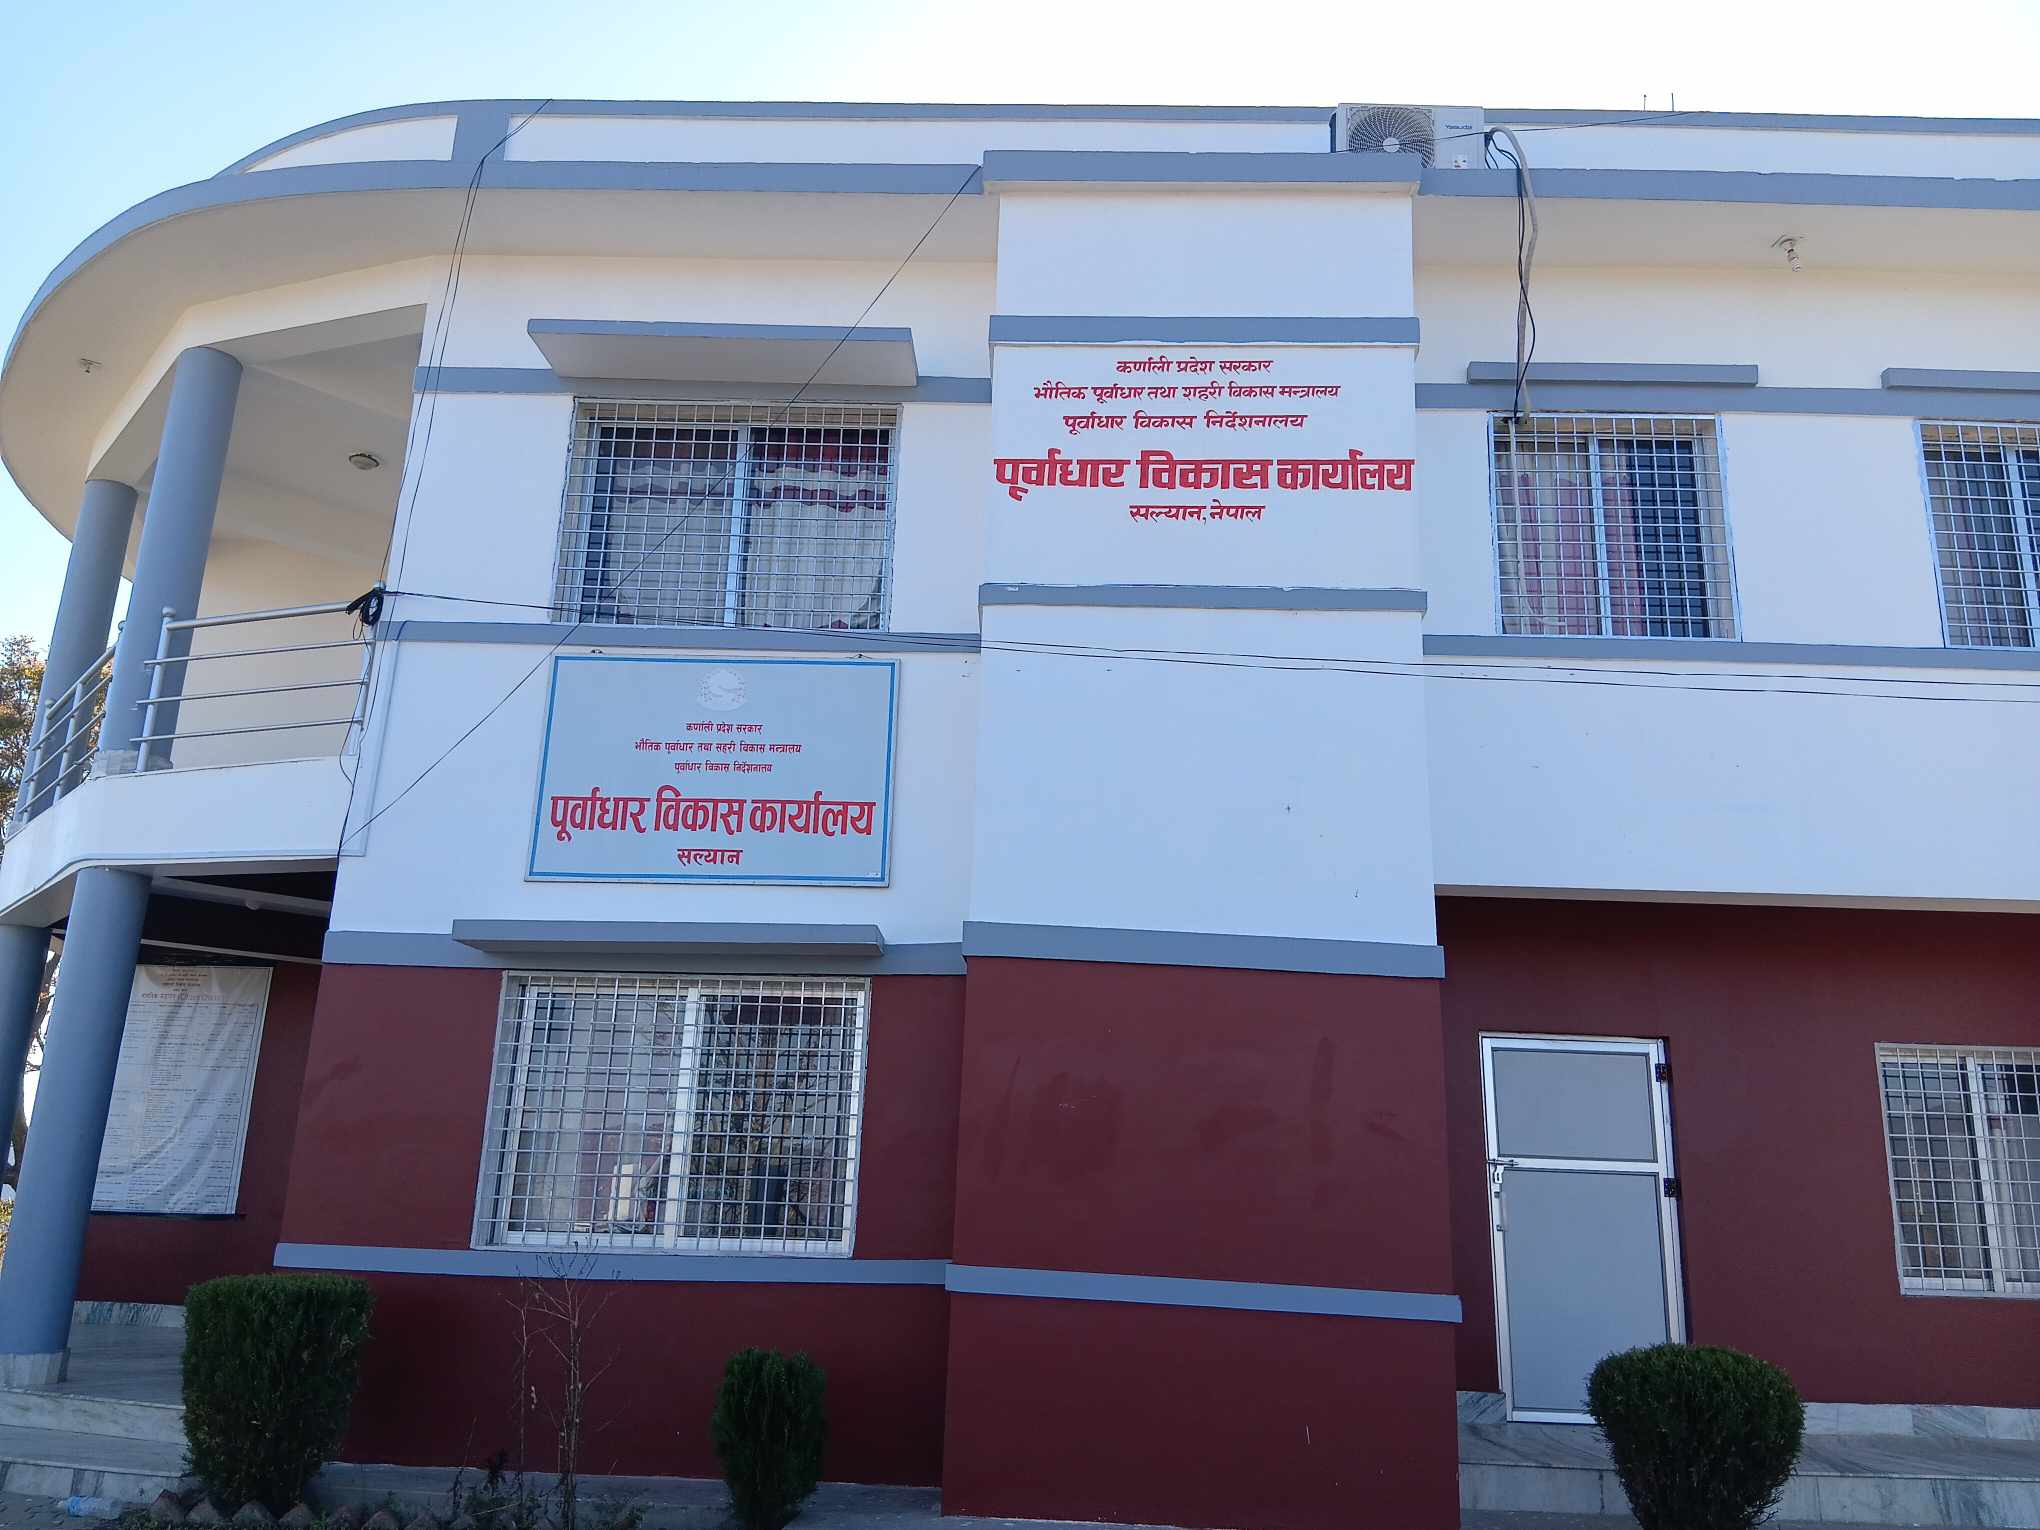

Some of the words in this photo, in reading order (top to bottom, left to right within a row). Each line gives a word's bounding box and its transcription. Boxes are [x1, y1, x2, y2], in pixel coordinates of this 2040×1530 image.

[1116, 355, 1173, 376] कर्णाली
[1176, 356, 1215, 375] प्रदेश
[1219, 360, 1274, 376] सरकार
[1034, 380, 1087, 400] भौतिक
[1091, 383, 1146, 405] पूर्वाधार
[1147, 386, 1178, 400] तथा
[1182, 380, 1225, 401] शहरी
[1226, 381, 1277, 399] विकास
[1278, 386, 1341, 399] मन्त्रालय
[1063, 408, 1127, 435] पूर्वाधार
[1133, 410, 1197, 430] विकास
[1203, 408, 1308, 432] निर्देशनालय
[993, 448, 1131, 501] पूर्वाधार
[1136, 450, 1273, 490] विकास
[1277, 449, 1415, 491] कार्यालय
[1208, 499, 1266, 522] नेपाल
[551, 787, 651, 842] पूर्वाधार
[654, 785, 747, 835] विकास
[749, 791, 876, 837] कार्यालय
[677, 849, 743, 867] सल्यान
